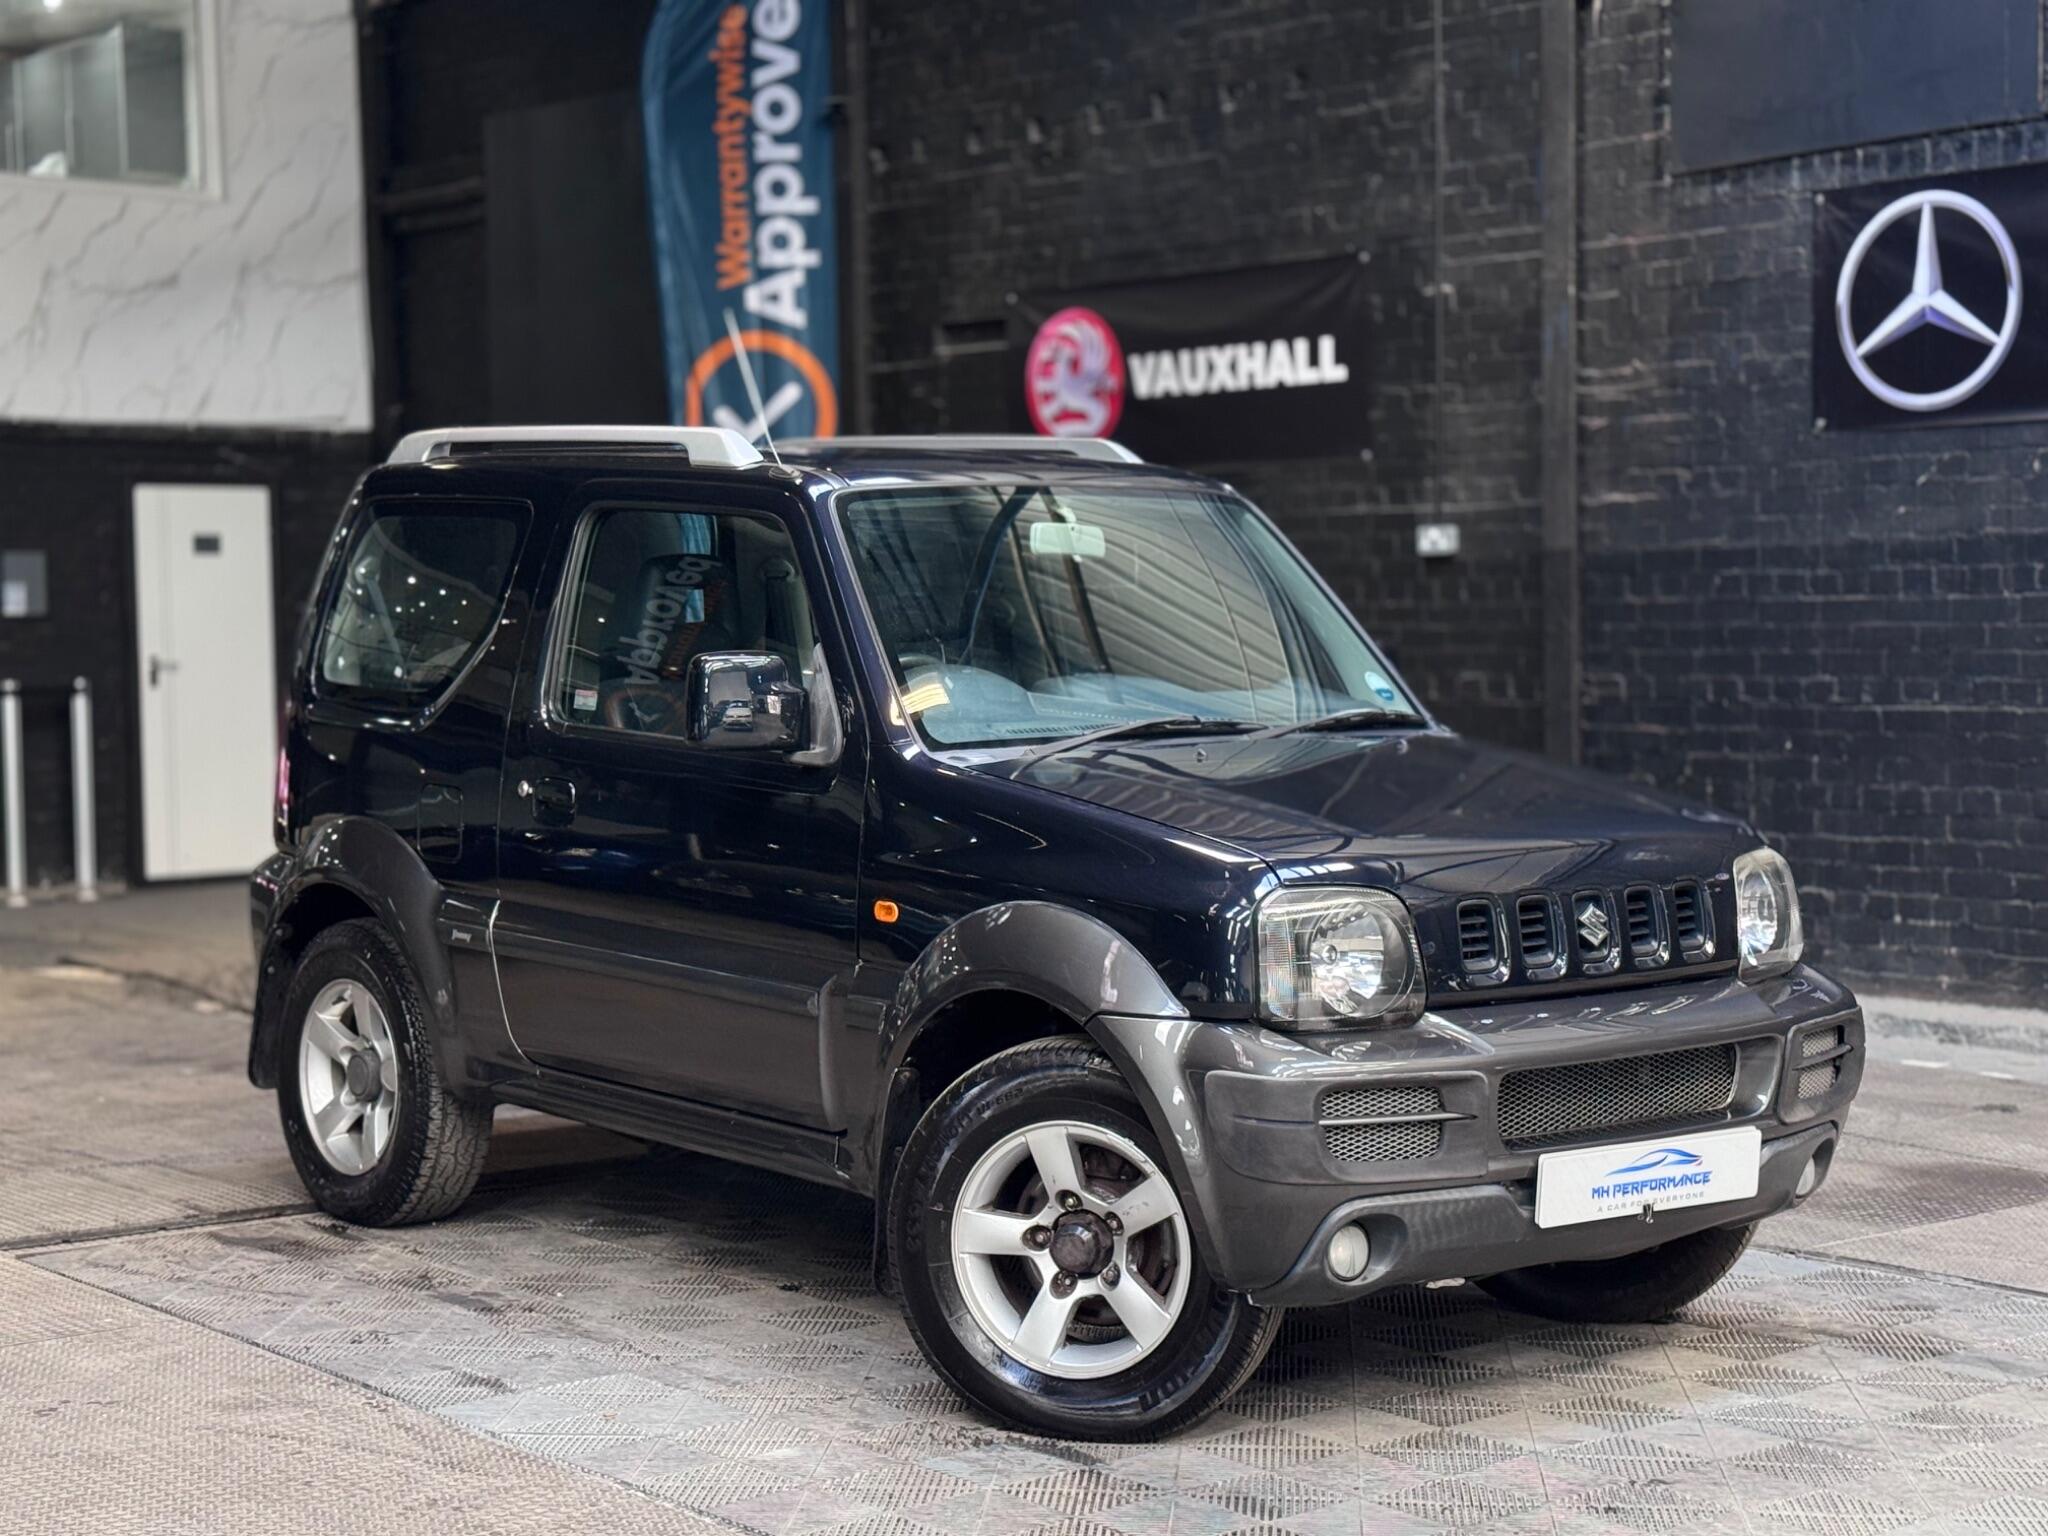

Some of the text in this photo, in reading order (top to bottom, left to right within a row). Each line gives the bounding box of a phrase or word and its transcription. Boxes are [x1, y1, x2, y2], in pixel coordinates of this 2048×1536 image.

[708, 3, 752, 291] Warrantywise
[1127, 333, 1349, 400] VAUXHALL
[1591, 1171, 1713, 1199] MH PERFORMANCE
[1607, 1203, 1627, 1211] CAR
